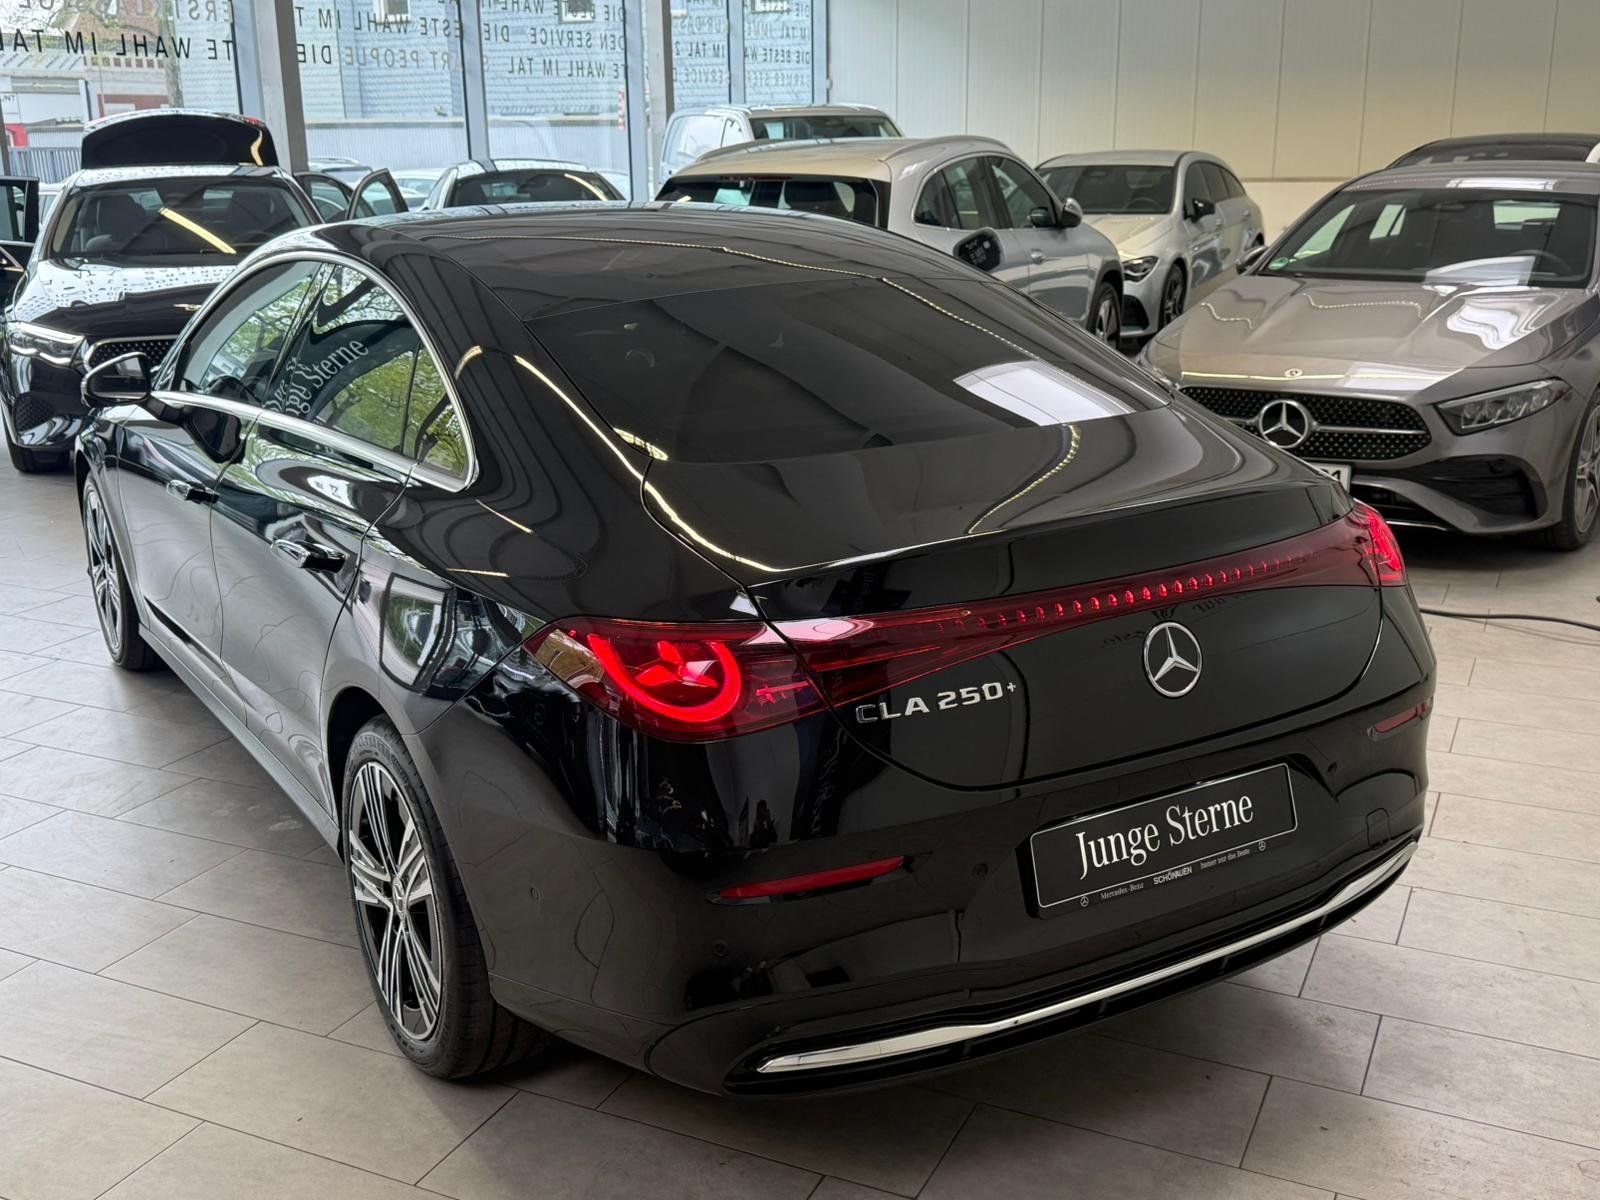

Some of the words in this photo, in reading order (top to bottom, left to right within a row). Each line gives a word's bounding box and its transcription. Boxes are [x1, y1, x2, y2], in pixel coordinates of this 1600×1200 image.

[295, 340, 369, 389] Sterne
[856, 697, 930, 724] CLA
[1076, 822, 1161, 880] Junge
[1166, 795, 1254, 847] Sterne
[1100, 882, 1145, 900] Mercedes-Benz
